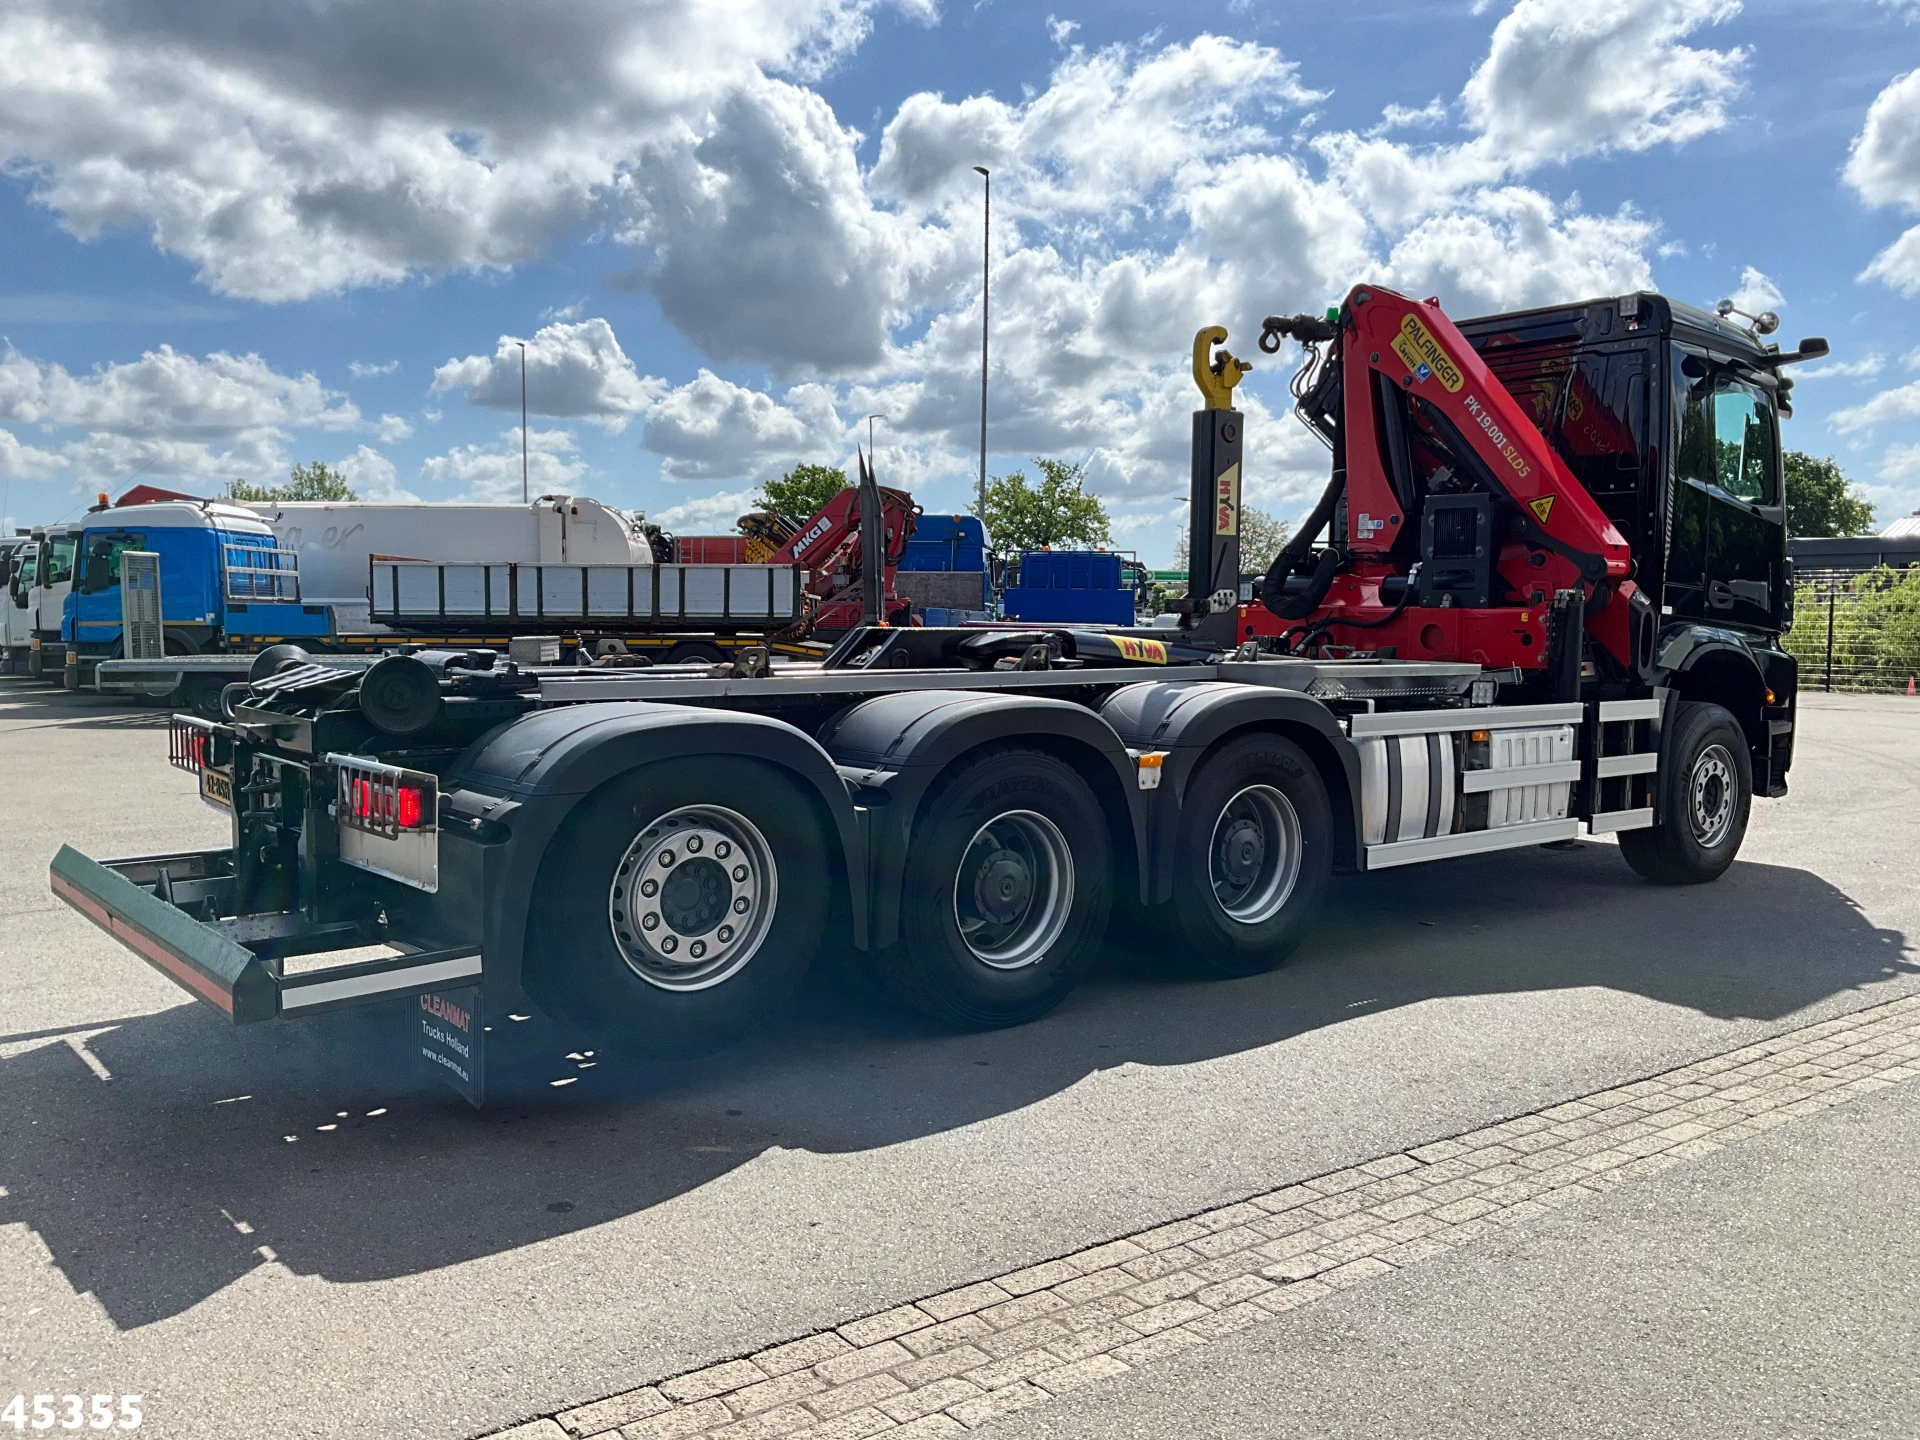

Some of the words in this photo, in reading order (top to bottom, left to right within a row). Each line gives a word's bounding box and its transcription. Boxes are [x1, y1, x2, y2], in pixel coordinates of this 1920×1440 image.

[1404, 317, 1460, 389] PALFINGER
[1463, 395, 1481, 415] PK
[1476, 411, 1507, 449] 19.001
[1219, 481, 1234, 531] HYVA
[793, 525, 823, 560] MKG
[1122, 640, 1164, 660] HYVA
[421, 994, 470, 1032] CLEANMAT
[422, 1020, 445, 1042] Trucks
[446, 1032, 469, 1058] Holland
[422, 1047, 469, 1082] www.cleanmat.eu
